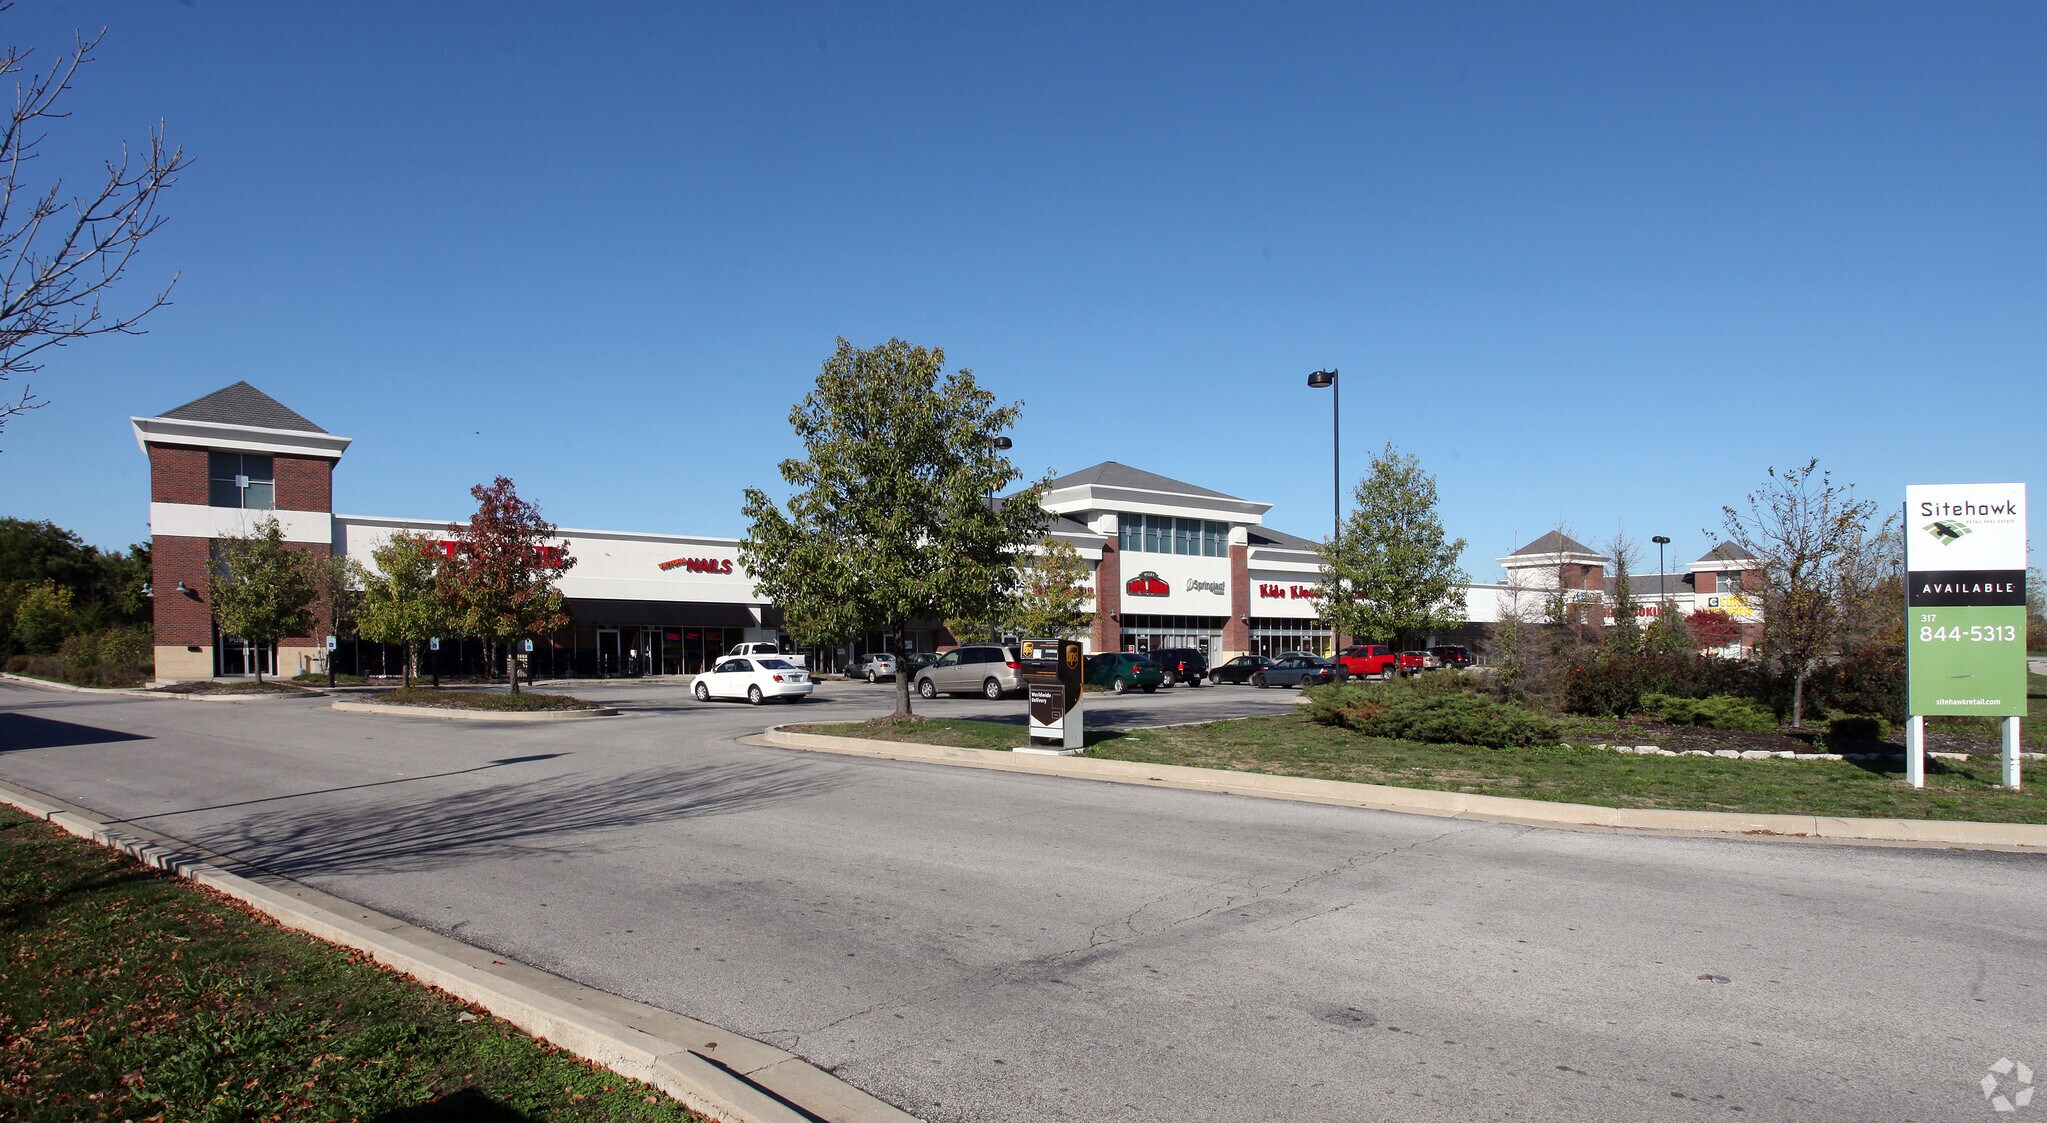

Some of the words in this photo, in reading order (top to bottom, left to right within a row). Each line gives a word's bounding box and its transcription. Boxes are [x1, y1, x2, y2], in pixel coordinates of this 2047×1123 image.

[1921, 500, 2016, 516] Sitehawk
[687, 558, 733, 575] NAILS
[1922, 583, 2013, 593] AVAILABLE
[1920, 614, 1936, 622] 317
[1920, 626, 2015, 641] 844-5313
